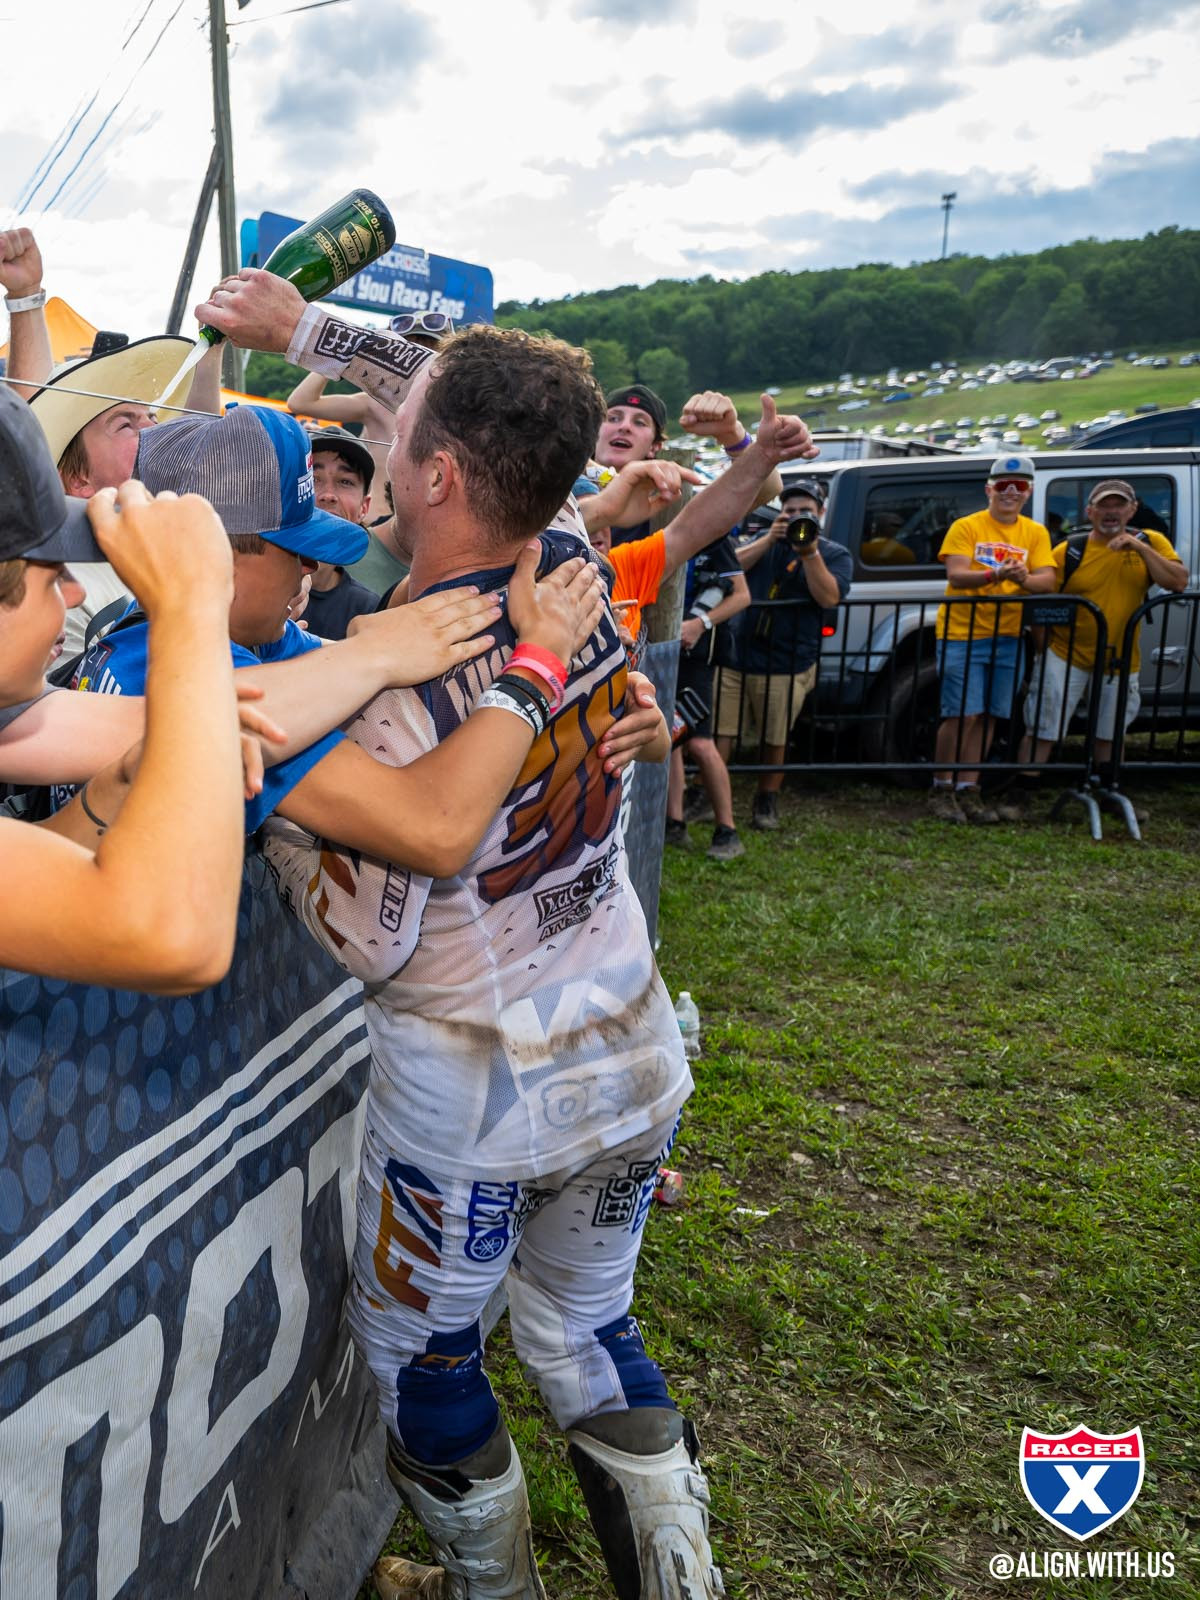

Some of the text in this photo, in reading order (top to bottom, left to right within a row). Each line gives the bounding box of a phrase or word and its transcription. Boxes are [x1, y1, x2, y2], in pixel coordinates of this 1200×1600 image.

[356, 273, 390, 304] You
[390, 280, 430, 311] Race
[429, 289, 466, 321] Fans
